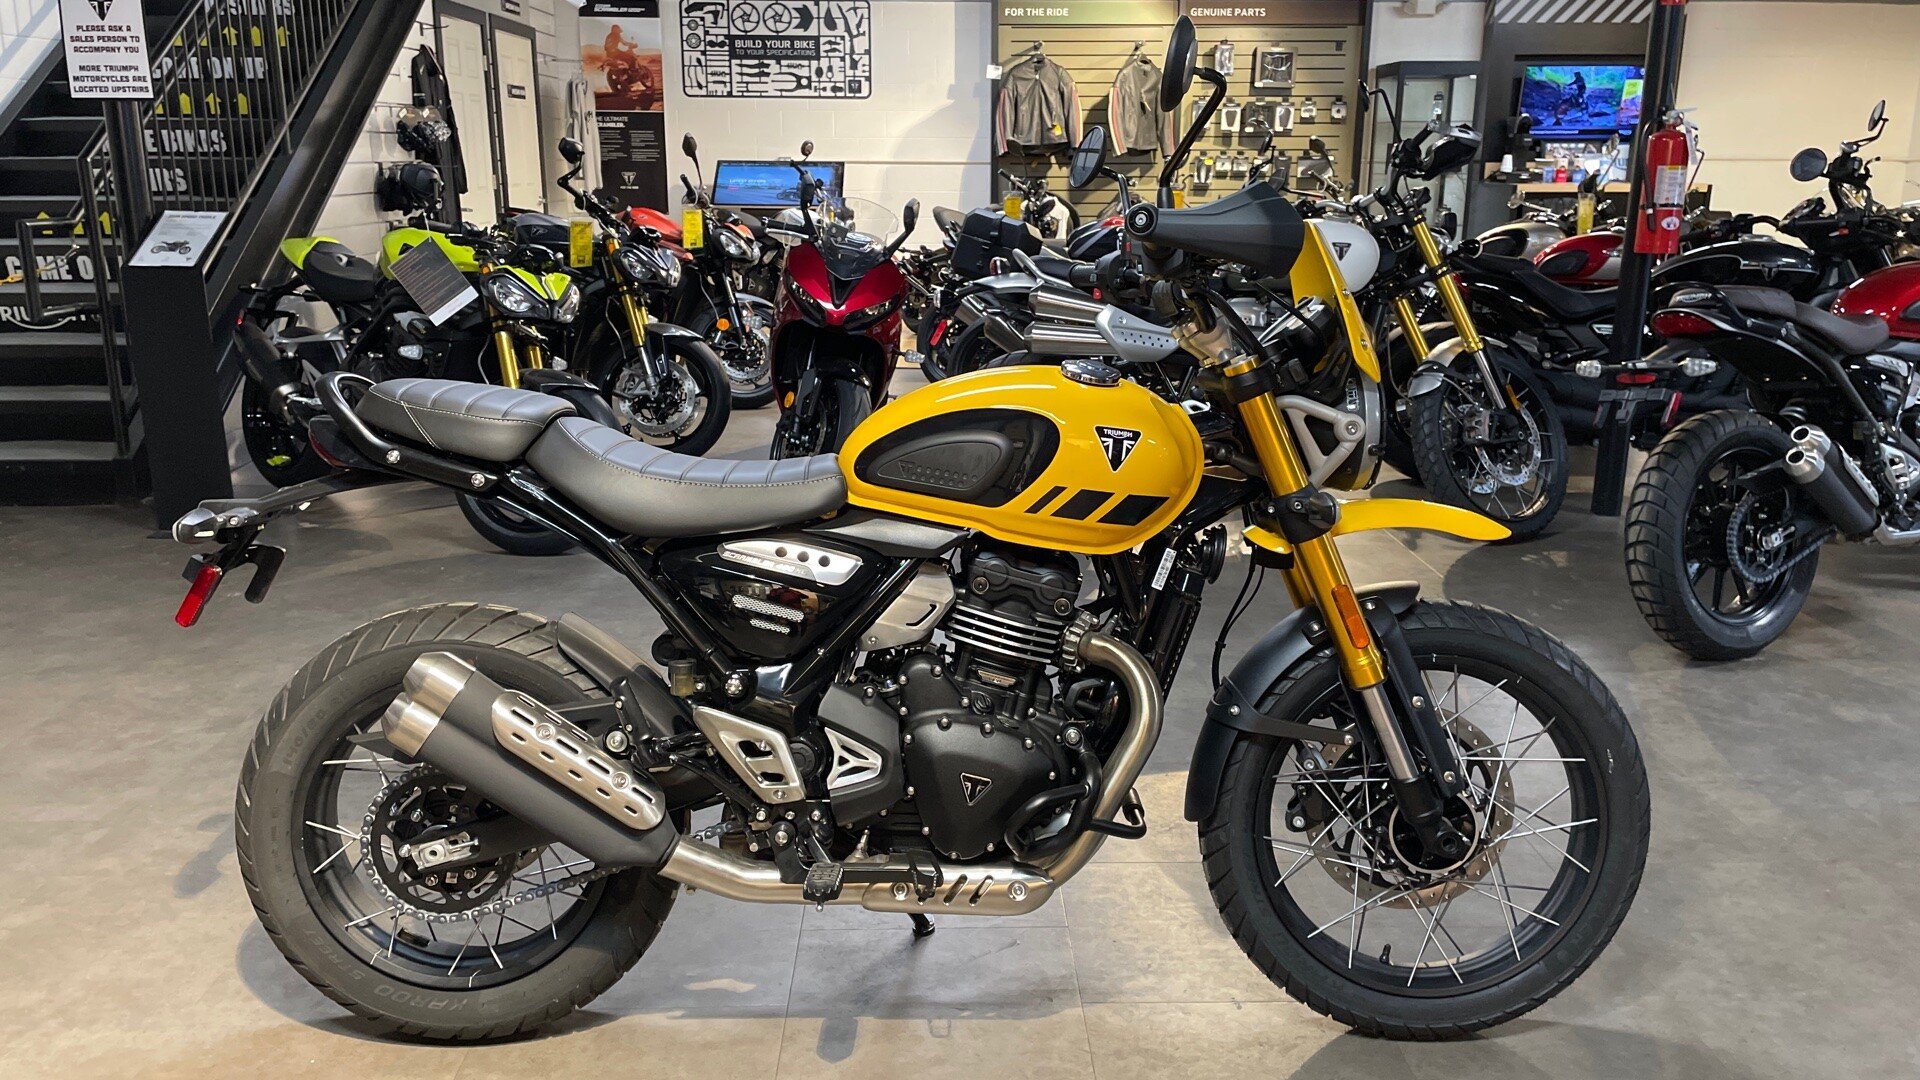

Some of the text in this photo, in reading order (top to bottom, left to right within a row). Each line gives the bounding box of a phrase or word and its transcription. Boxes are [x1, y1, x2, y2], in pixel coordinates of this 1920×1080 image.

[1004, 7, 1069, 17] FOR THE RIDE
[1190, 7, 1266, 17] GENUINE PARTS
[734, 39, 816, 49] BUILD YOUR BIKE
[746, 48, 765, 56] YOUR
[766, 48, 816, 57] SPECIFICATIONS
[5, 255, 73, 280] CME
[1103, 429, 1133, 439] TRIUMPH
